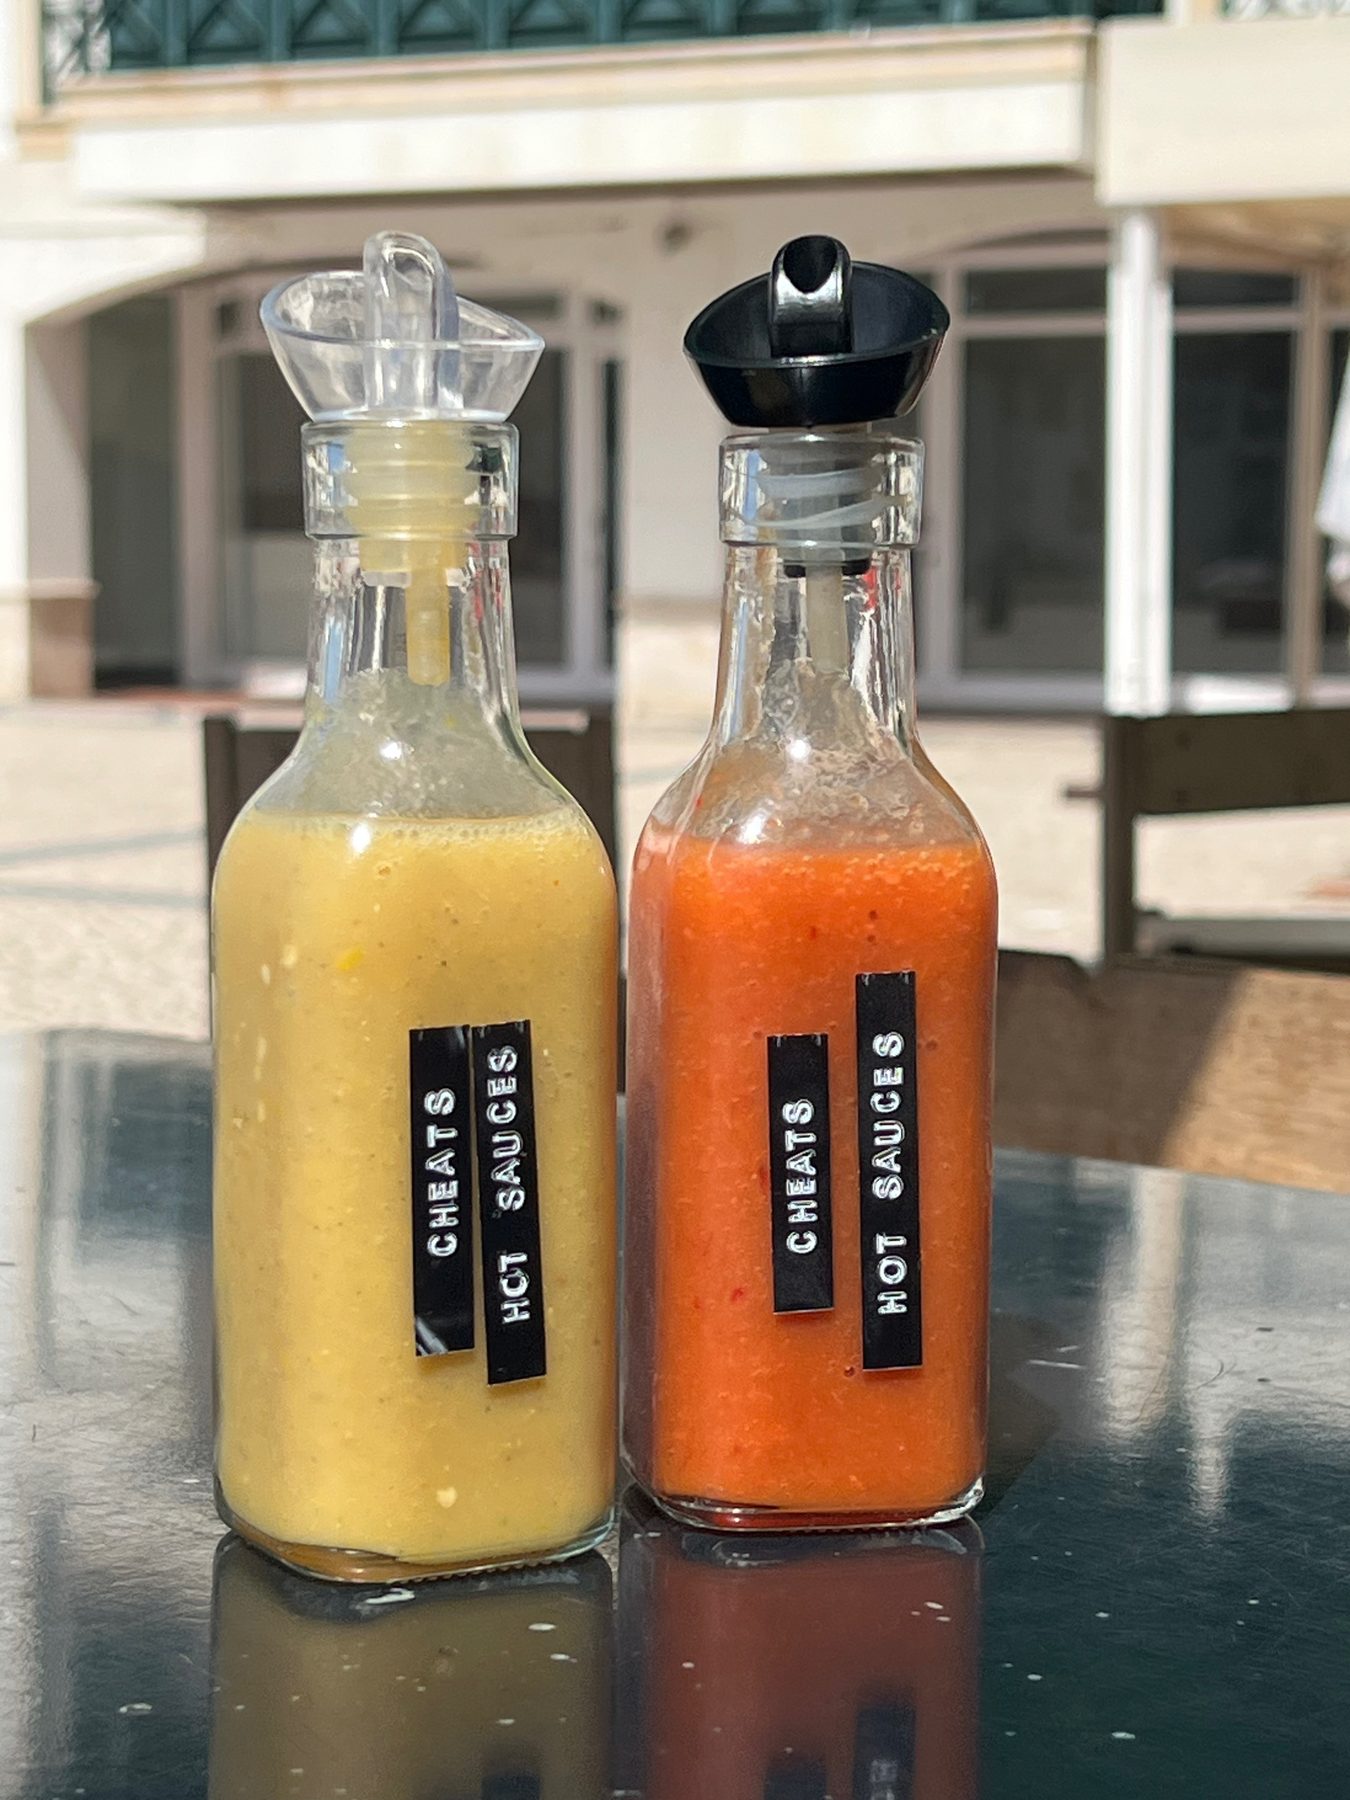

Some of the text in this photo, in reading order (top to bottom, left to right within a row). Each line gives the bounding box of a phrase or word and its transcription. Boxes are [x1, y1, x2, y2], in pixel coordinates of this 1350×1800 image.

[424, 1088, 459, 1257] CHEATS
[487, 1046, 531, 1324] HOT SAUCES
[783, 1099, 818, 1254] CHEATS
[871, 1031, 907, 1315] HOT SAUCES
